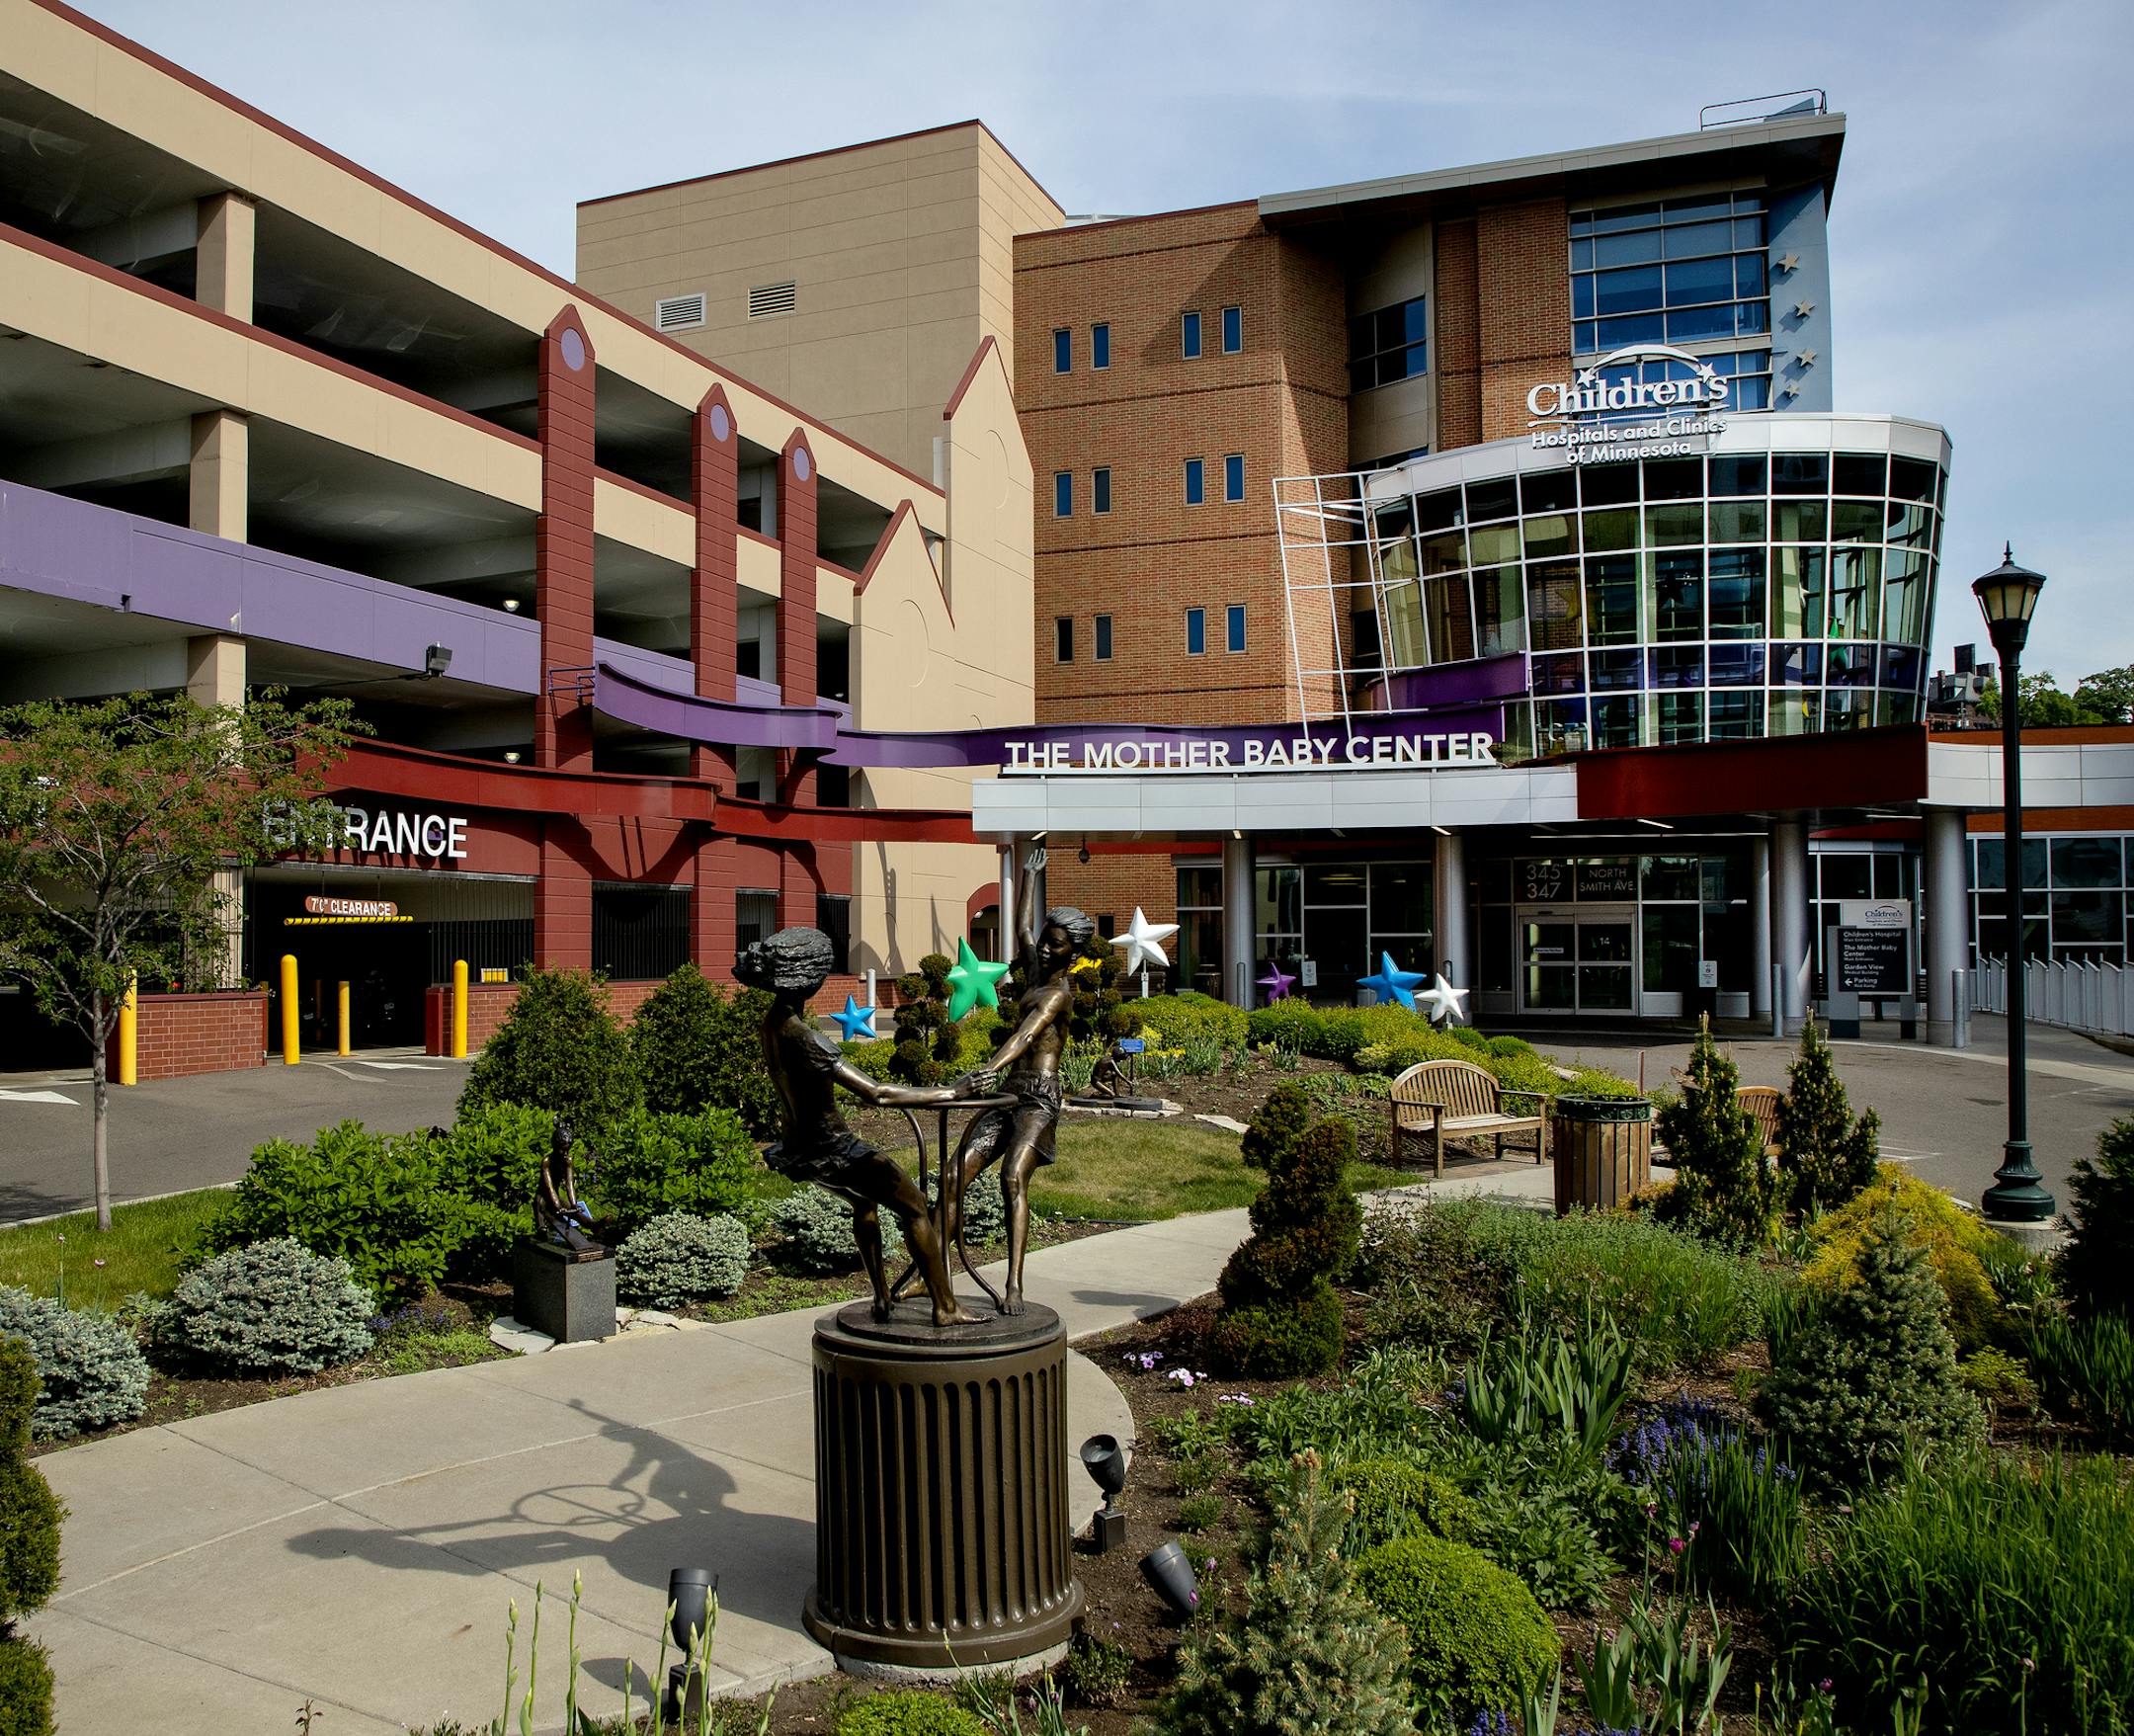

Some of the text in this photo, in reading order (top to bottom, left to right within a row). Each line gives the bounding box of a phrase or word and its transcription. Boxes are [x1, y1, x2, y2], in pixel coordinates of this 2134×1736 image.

[1526, 374, 1729, 417] Children's
[1531, 415, 1728, 449] Hospitals and Clinics
[1566, 441, 1691, 465] of Minnesota
[1004, 731, 1494, 769] THE MOTHER BABY CENTER
[1526, 865, 1561, 880] 345
[1589, 868, 1627, 878] NORTH
[1526, 882, 1561, 899] 347
[1581, 880, 1637, 892] SMITH AVE.
[330, 899, 391, 917] CLEARANCE
